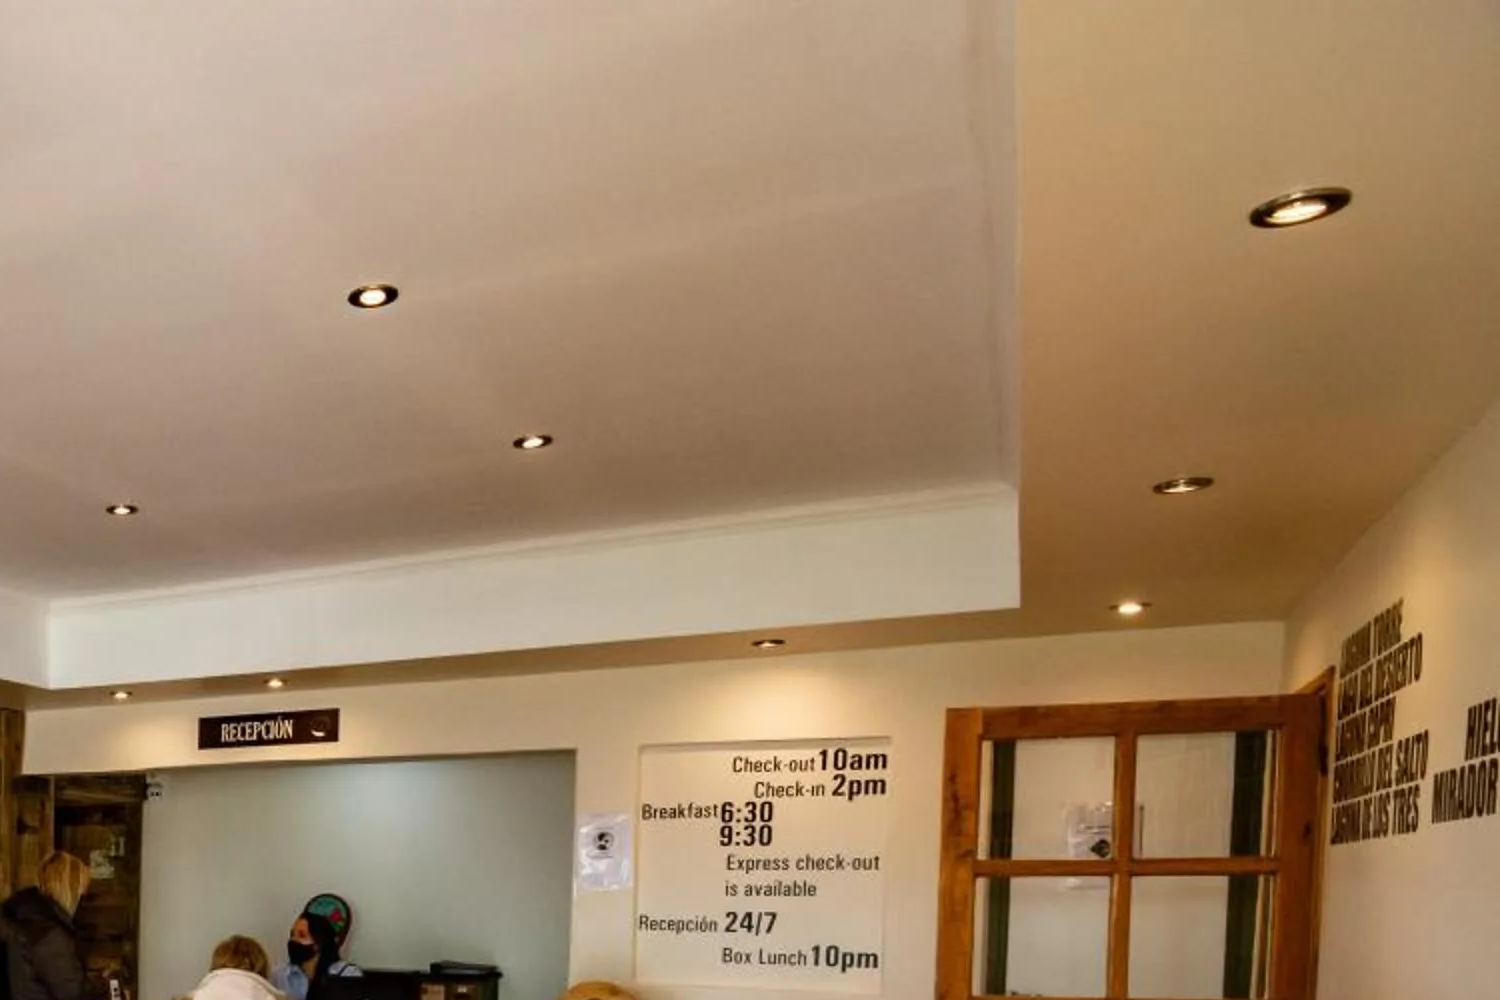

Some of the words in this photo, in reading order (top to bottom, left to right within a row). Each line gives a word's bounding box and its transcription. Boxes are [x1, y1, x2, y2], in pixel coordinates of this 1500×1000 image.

[221, 716, 293, 742] RECEPCIÓN
[732, 756, 815, 773] Check-out
[819, 748, 888, 771] 10am
[1395, 729, 1428, 785] SALTO
[754, 782, 825, 798] Check-in
[832, 774, 886, 801] 2pm
[1431, 758, 1498, 824] MIRADOR
[642, 803, 719, 820] Breakfast
[720, 801, 774, 823] 6:30
[1392, 783, 1420, 836] TRES
[719, 825, 773, 847] 9:30
[726, 854, 790, 874] Express
[795, 854, 880, 871] check-out
[725, 880, 738, 897] is
[744, 880, 818, 898] available
[638, 913, 718, 933] Recepción
[723, 911, 778, 936] 24/7
[721, 948, 752, 965] Box
[758, 948, 807, 967] Lunch
[811, 945, 879, 973] 10pm
